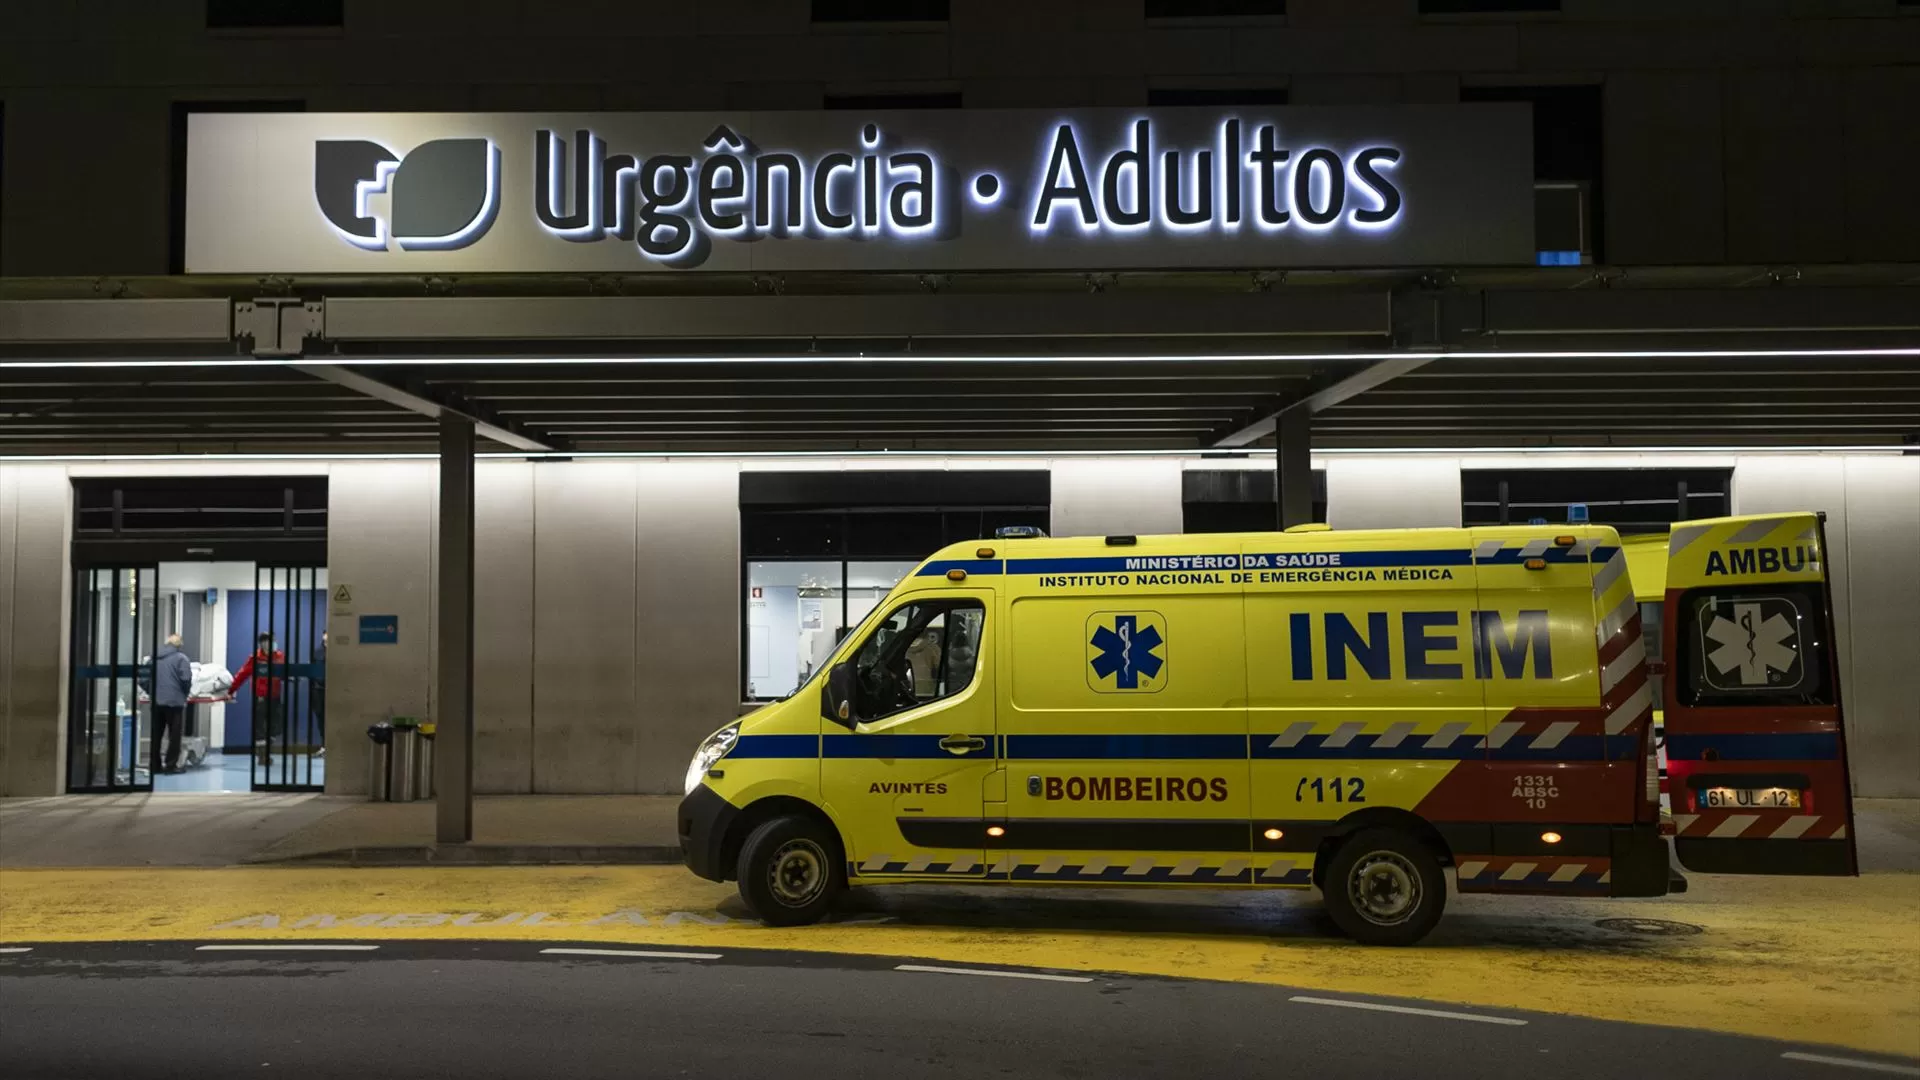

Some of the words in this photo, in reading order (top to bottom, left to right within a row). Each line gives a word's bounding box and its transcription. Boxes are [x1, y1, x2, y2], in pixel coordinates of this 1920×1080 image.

[535, 124, 933, 255] Urgência
[1033, 118, 1401, 225] Adultos
[1125, 555, 1237, 570] MINISTÉRIO
[1243, 555, 1269, 568] DA
[1275, 552, 1341, 567] SAÚDE
[1039, 575, 1130, 587] INSTITUTO
[1136, 573, 1225, 585] NACIONAL
[1230, 573, 1254, 584] DE
[1259, 568, 1377, 583] EMERGÊNCIA
[1383, 567, 1453, 580] MÉDICA
[1289, 610, 1553, 680] INEM
[868, 782, 948, 795] AVINTES
[1045, 777, 1229, 802] BOMBEIROS
[1310, 777, 1366, 802] 112
[1514, 776, 1555, 786] 1331
[1512, 787, 1559, 798] ABSC
[1526, 799, 1546, 809] 10
